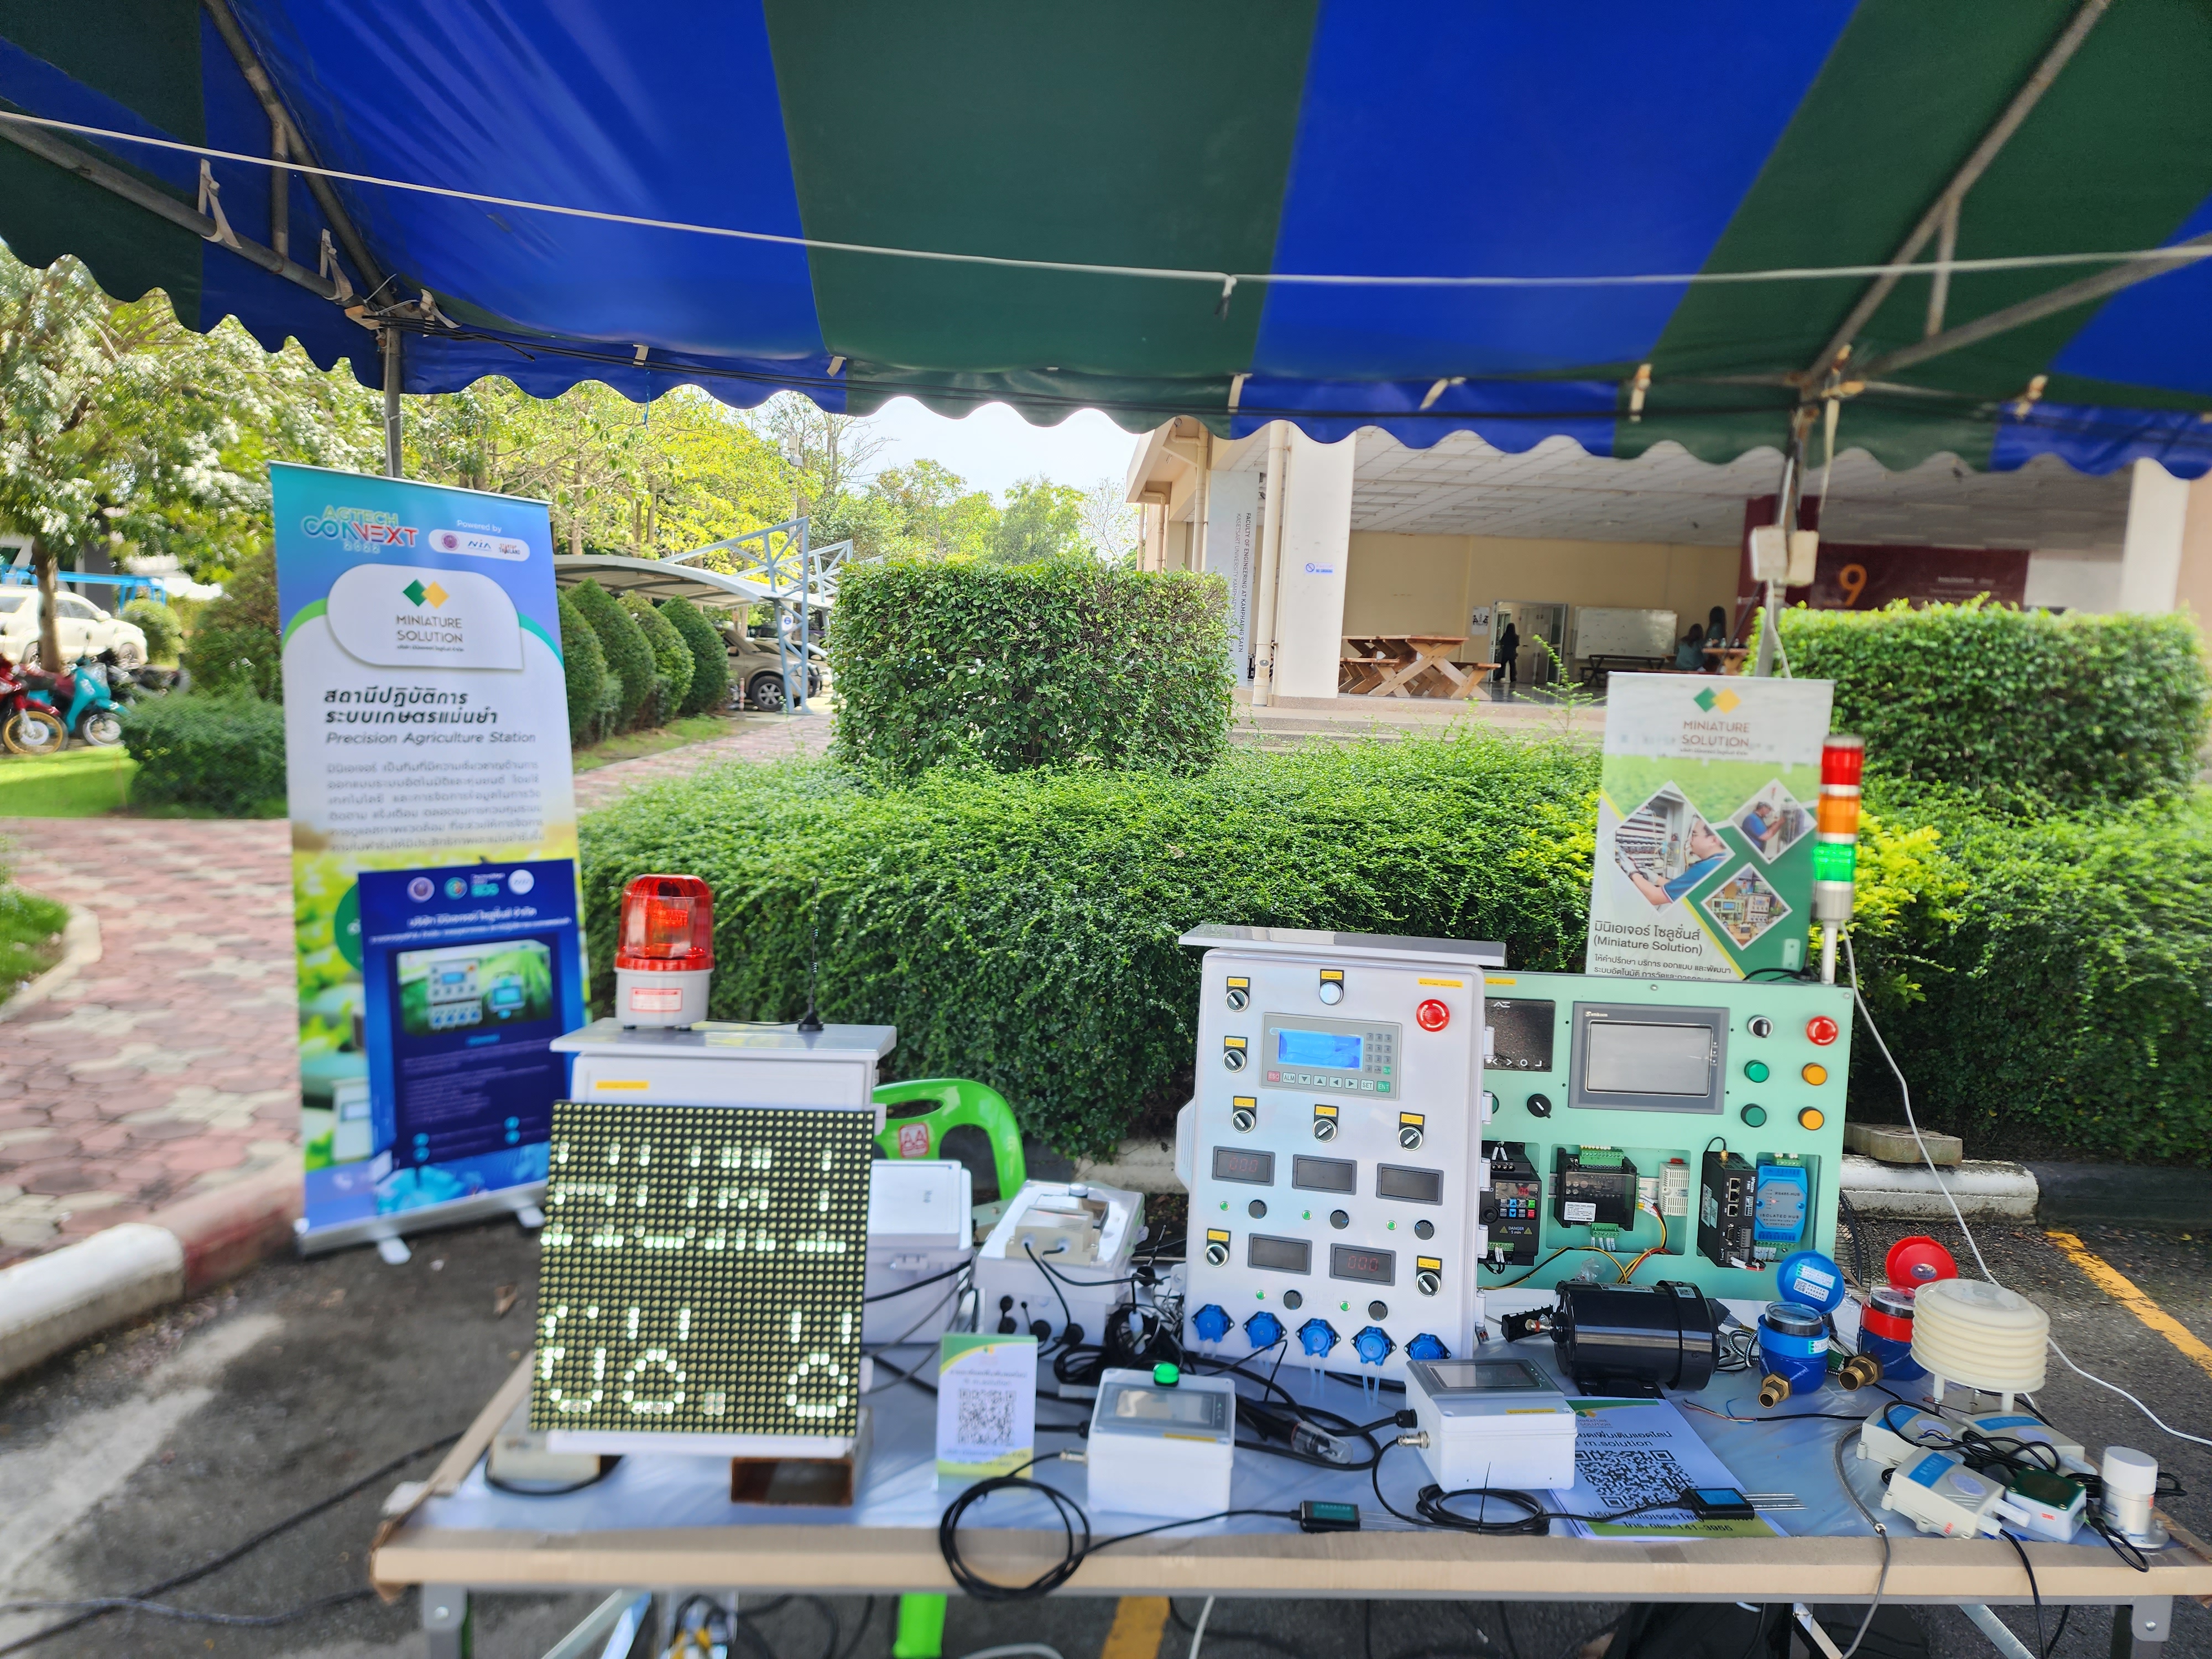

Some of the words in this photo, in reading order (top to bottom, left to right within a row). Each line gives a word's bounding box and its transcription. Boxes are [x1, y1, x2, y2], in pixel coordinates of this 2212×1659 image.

[323, 505, 398, 525] AGTECH
[457, 519, 491, 531] Powered
[492, 524, 502, 533] by
[343, 542, 380, 553] 2022
[1839, 564, 1868, 606] 9
[396, 614, 462, 628] MINIATURE
[397, 630, 463, 643] SOLUTION
[324, 686, 468, 707] สถานีปฏิบัติการ
[325, 707, 499, 724] ระบบเกษตรแม่นยำ
[1683, 721, 1750, 733] MINIATURE
[326, 732, 397, 744] Precision
[403, 732, 483, 745] Agriculture
[489, 732, 536, 743] Station
[1682, 734, 1749, 747] SOLUTION
[1594, 920, 1651, 936] มินิเอเจอร์
[1654, 924, 1701, 941] โซลูชั่นส์
[1594, 935, 1649, 949] (Miniature
[1652, 941, 1703, 956] Solution)
[1595, 954, 1636, 965] ให้คำปรึกษา
[1694, 964, 1731, 974] และพัฒนา
[1594, 967, 1640, 977] ระบบอัตโนมัติ
[1348, 1256, 1379, 1272] 000
